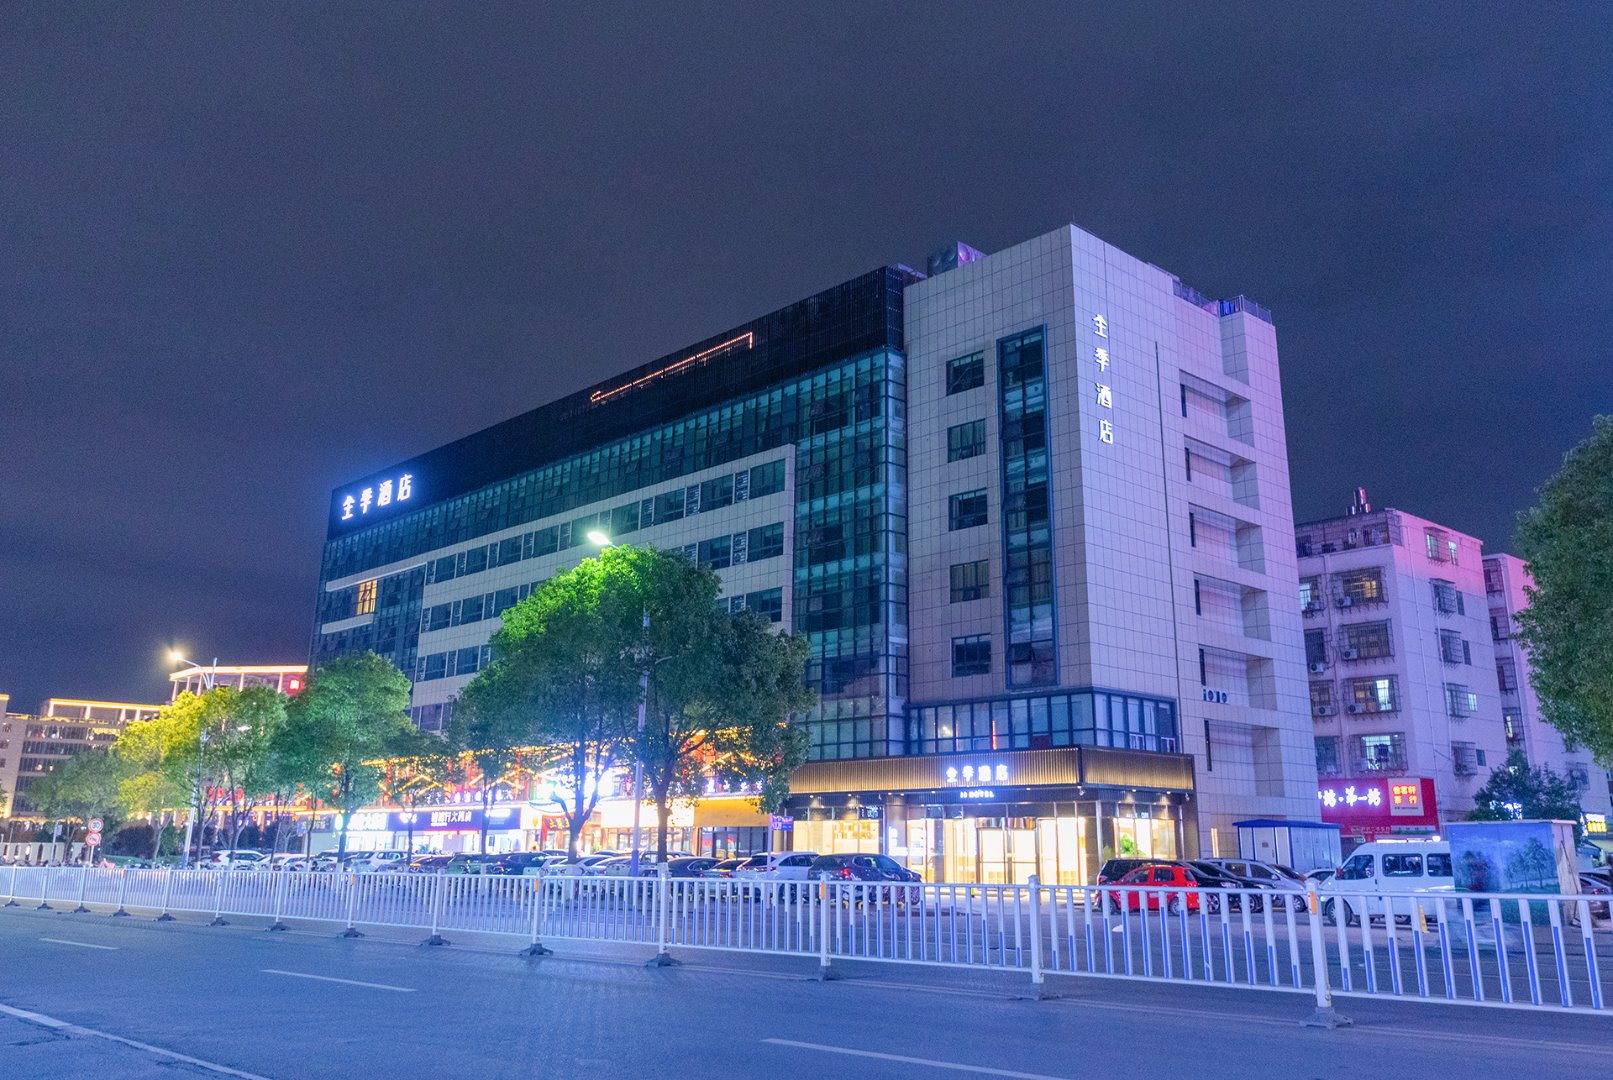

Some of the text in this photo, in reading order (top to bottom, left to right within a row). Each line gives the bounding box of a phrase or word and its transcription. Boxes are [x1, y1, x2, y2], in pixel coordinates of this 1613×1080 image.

[1092, 313, 1114, 445] 全季酒店
[341, 473, 413, 521] 全季酒店
[945, 764, 1008, 783] 全季酒店
